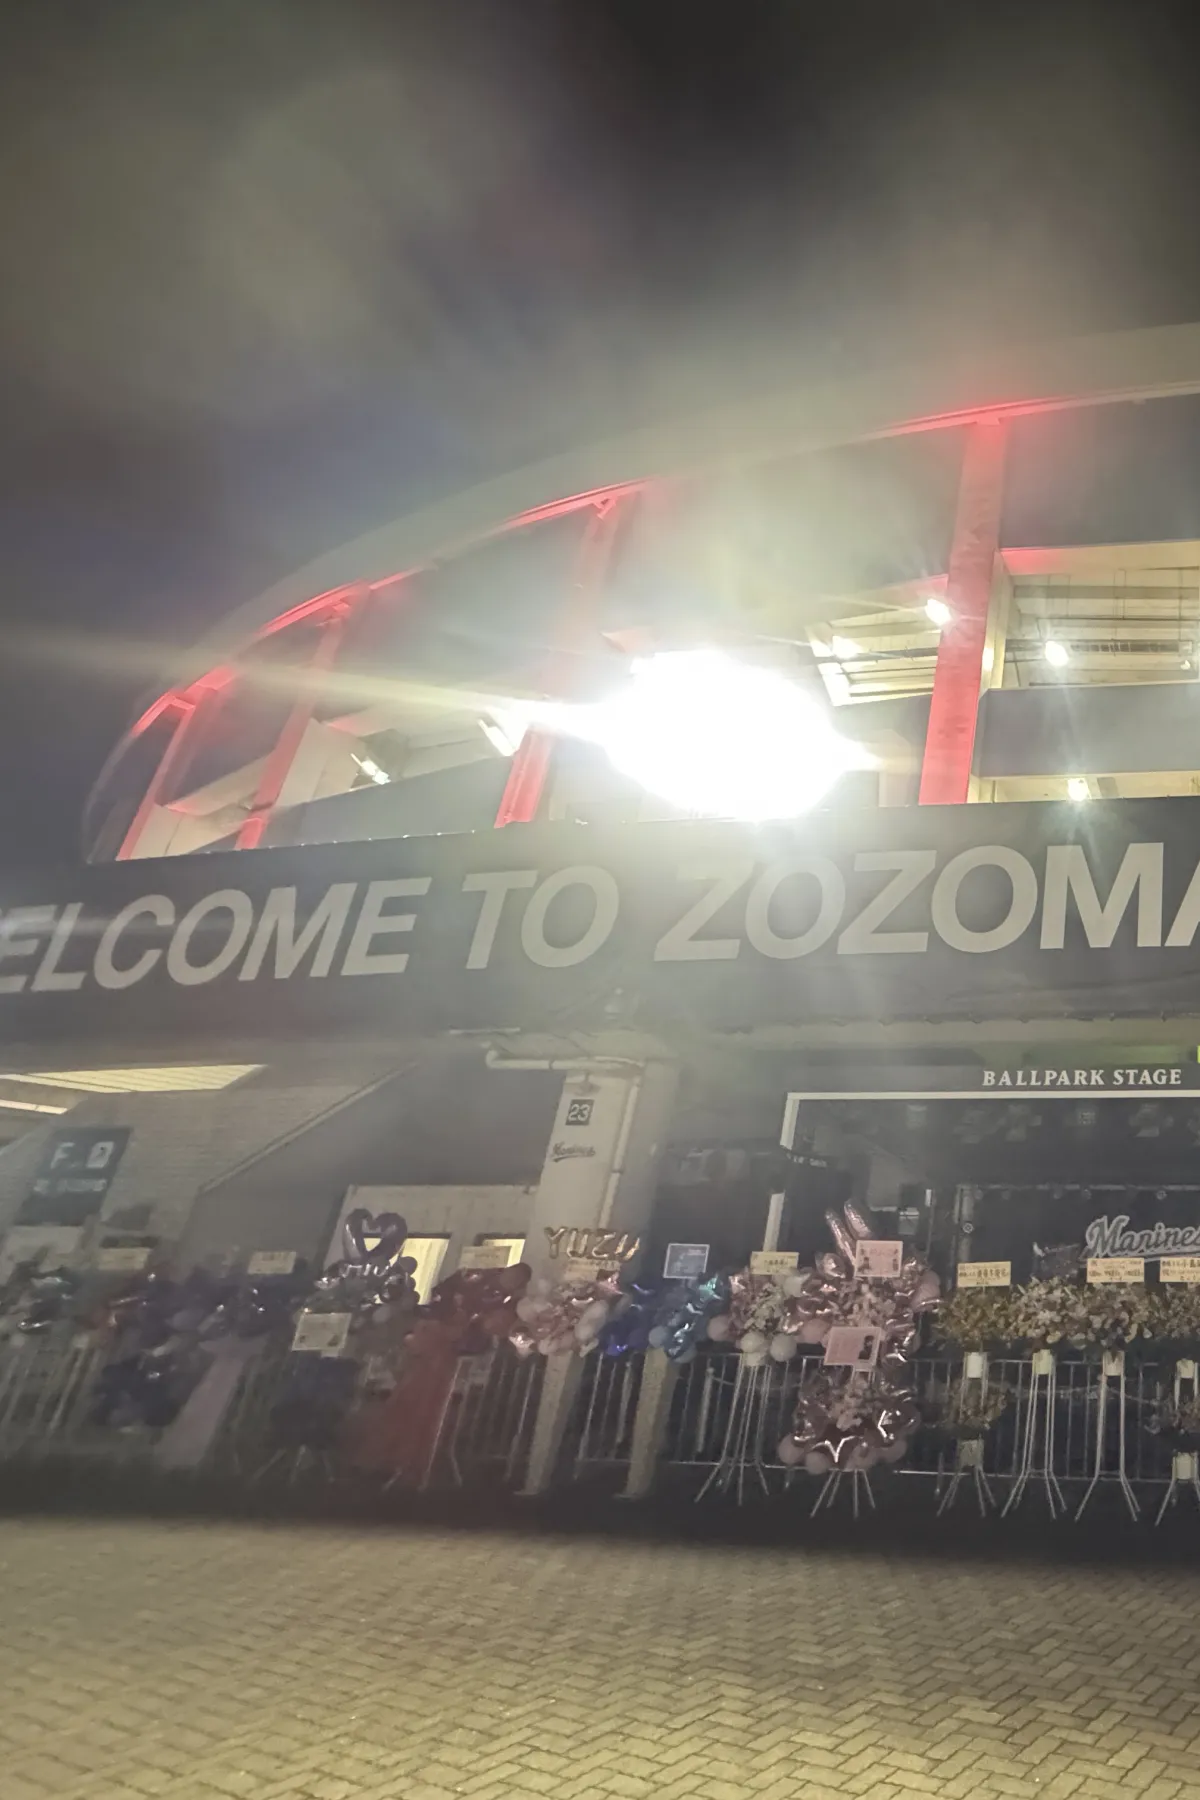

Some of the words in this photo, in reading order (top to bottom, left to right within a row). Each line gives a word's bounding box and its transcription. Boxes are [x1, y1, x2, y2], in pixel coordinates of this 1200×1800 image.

[0, 877, 432, 994] ELCOME
[461, 866, 620, 970] TO
[981, 1070, 1106, 1087] BALLPARK
[1112, 1068, 1183, 1086] STAGE
[567, 1103, 591, 1122] 23
[543, 1226, 641, 1262] YUZU
